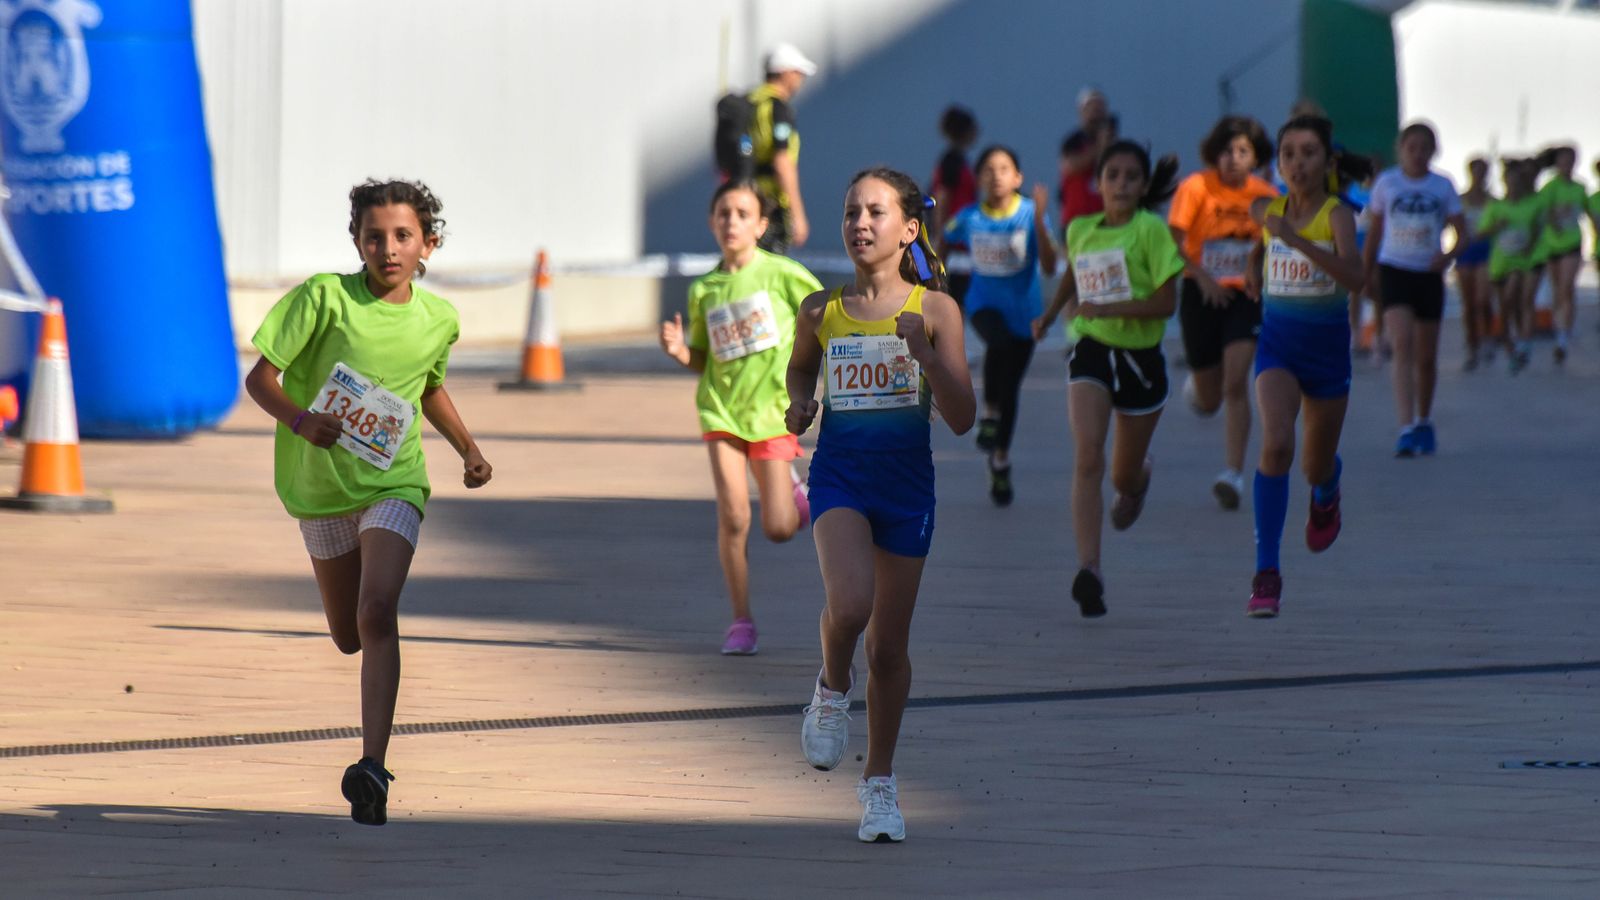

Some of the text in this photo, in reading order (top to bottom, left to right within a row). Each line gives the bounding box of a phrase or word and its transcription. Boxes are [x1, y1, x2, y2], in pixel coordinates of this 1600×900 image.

[97, 150, 132, 177] DE
[1272, 257, 1310, 280] 1198
[831, 344, 846, 356] XXI
[335, 369, 353, 386] XXI
[833, 363, 889, 390] 1200
[323, 389, 378, 437] 1348
